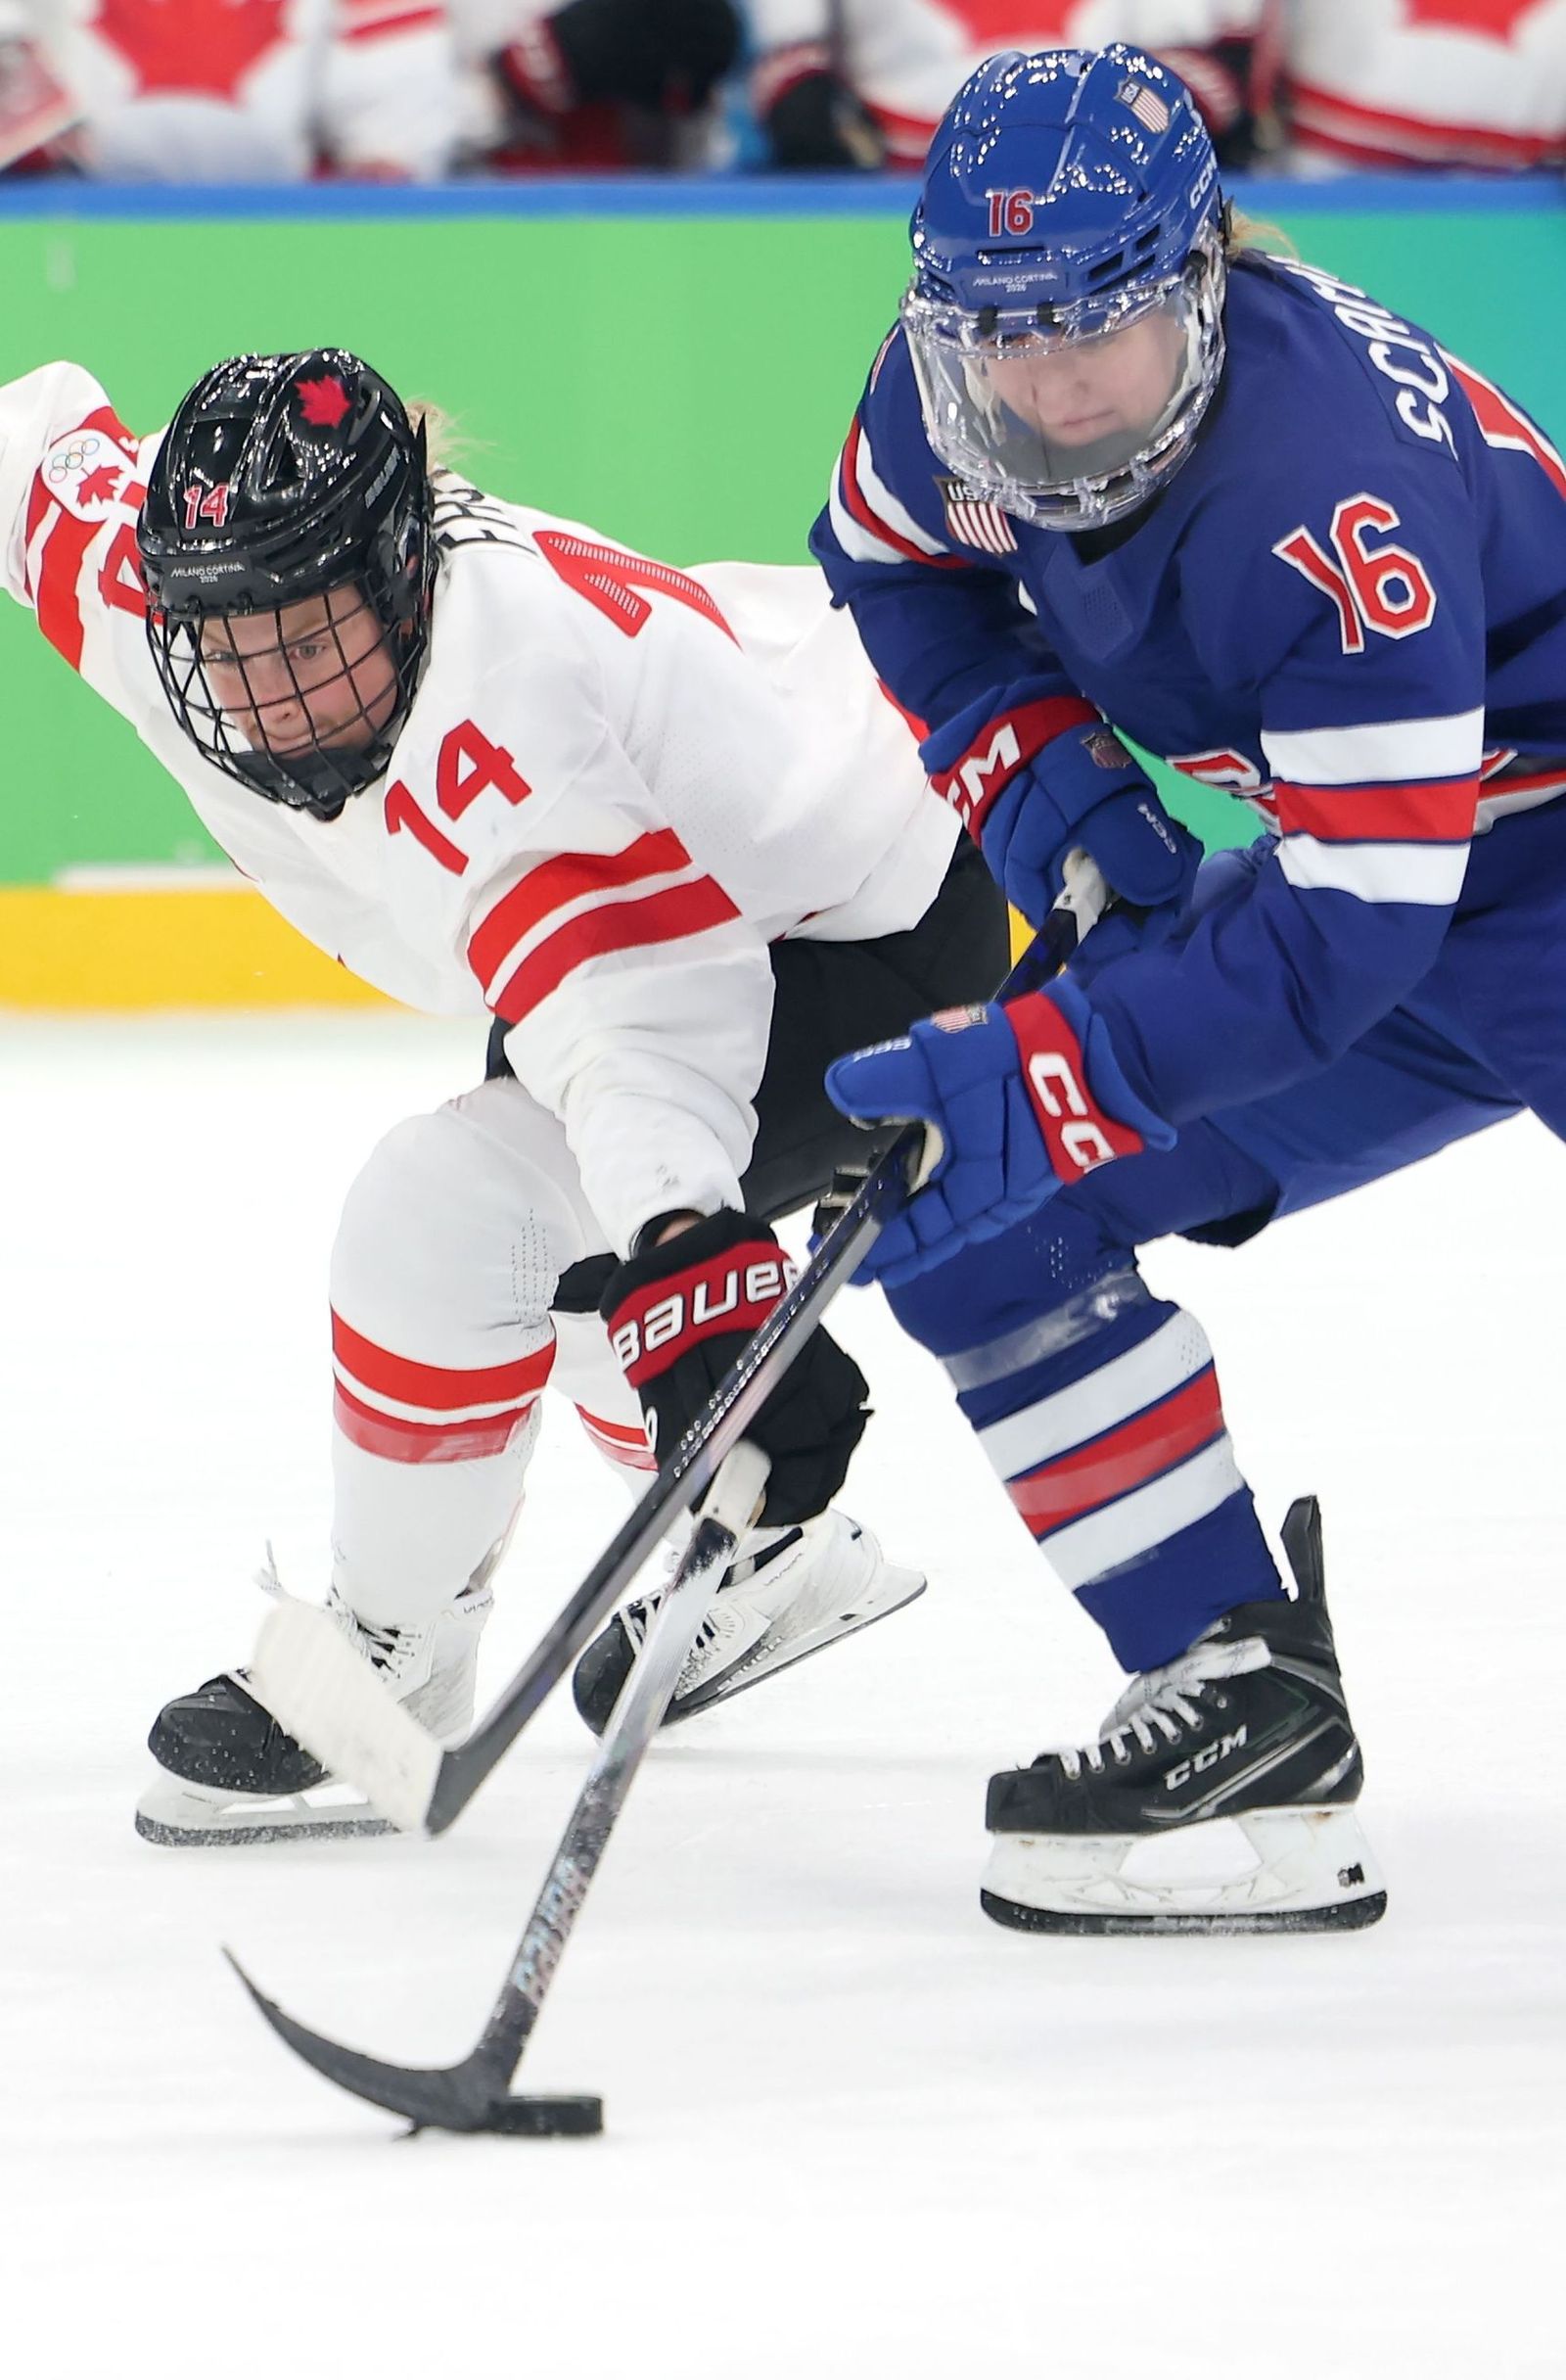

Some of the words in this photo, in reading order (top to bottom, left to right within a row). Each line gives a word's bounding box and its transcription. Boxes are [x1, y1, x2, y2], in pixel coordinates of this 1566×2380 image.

[986, 189, 1034, 237] 16
[973, 277, 1013, 287] MILANO
[1014, 273, 1058, 285] CORTINA
[1266, 256, 1459, 462] SCAM
[183, 482, 229, 529] 14
[946, 481, 989, 501] US
[170, 567, 205, 579] MILANO
[206, 561, 245, 576] CORTINA
[1272, 492, 1437, 655] 16
[385, 720, 531, 875] 14
[1029, 1051, 1117, 1174] CC
[1165, 1724, 1247, 1791] CCM
